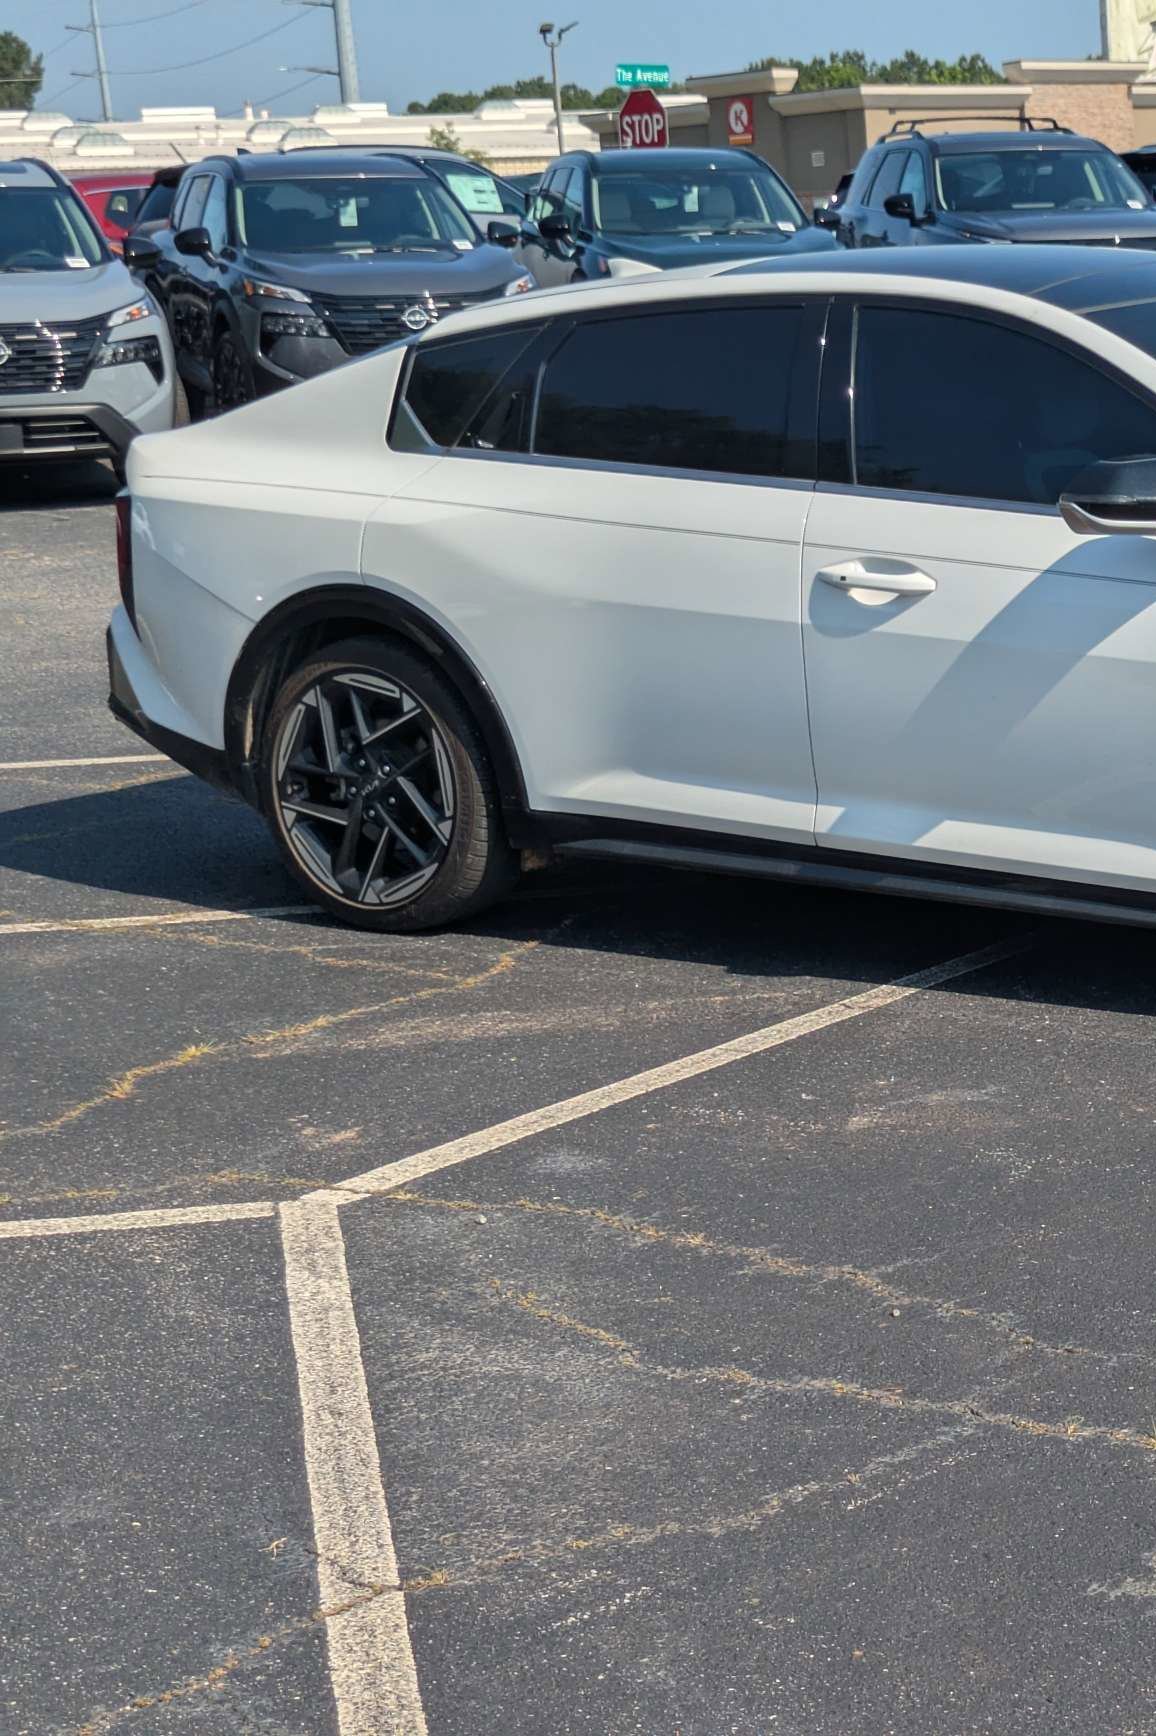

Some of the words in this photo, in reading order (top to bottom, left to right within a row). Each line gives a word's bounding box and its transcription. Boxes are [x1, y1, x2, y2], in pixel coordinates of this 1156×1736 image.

[616, 68, 633, 82] The
[636, 69, 669, 82] Avenue
[622, 113, 664, 145] STOP
